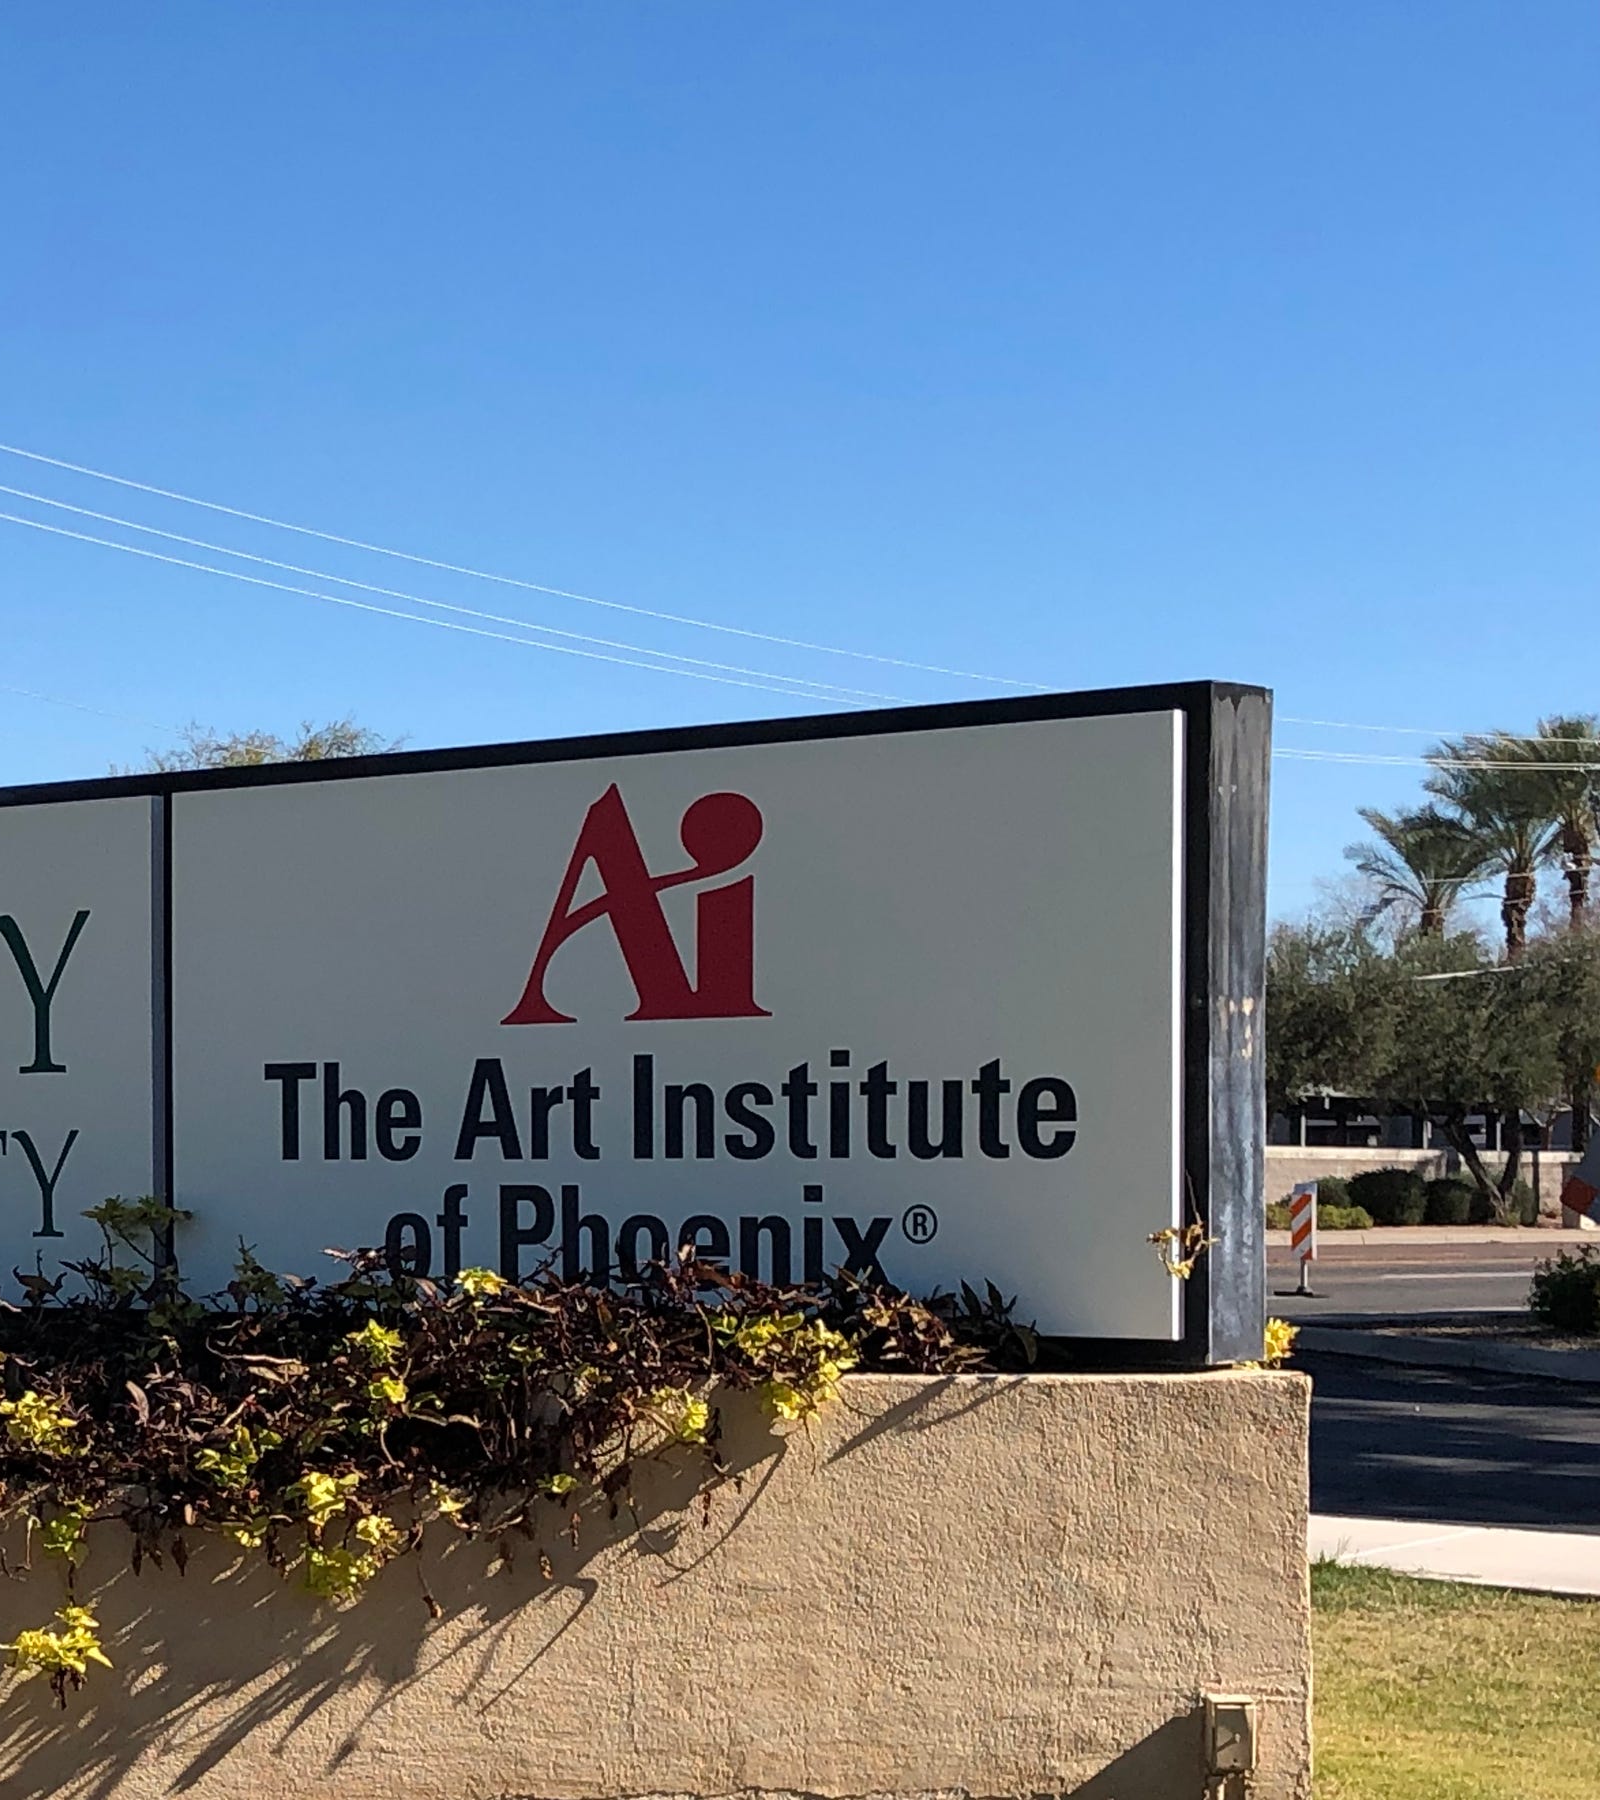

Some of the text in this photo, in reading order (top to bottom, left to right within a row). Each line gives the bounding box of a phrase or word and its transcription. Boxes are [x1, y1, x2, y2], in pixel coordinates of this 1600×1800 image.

[500, 783, 773, 1026] Ai
[263, 1049, 1079, 1162] The Art Institute
[385, 1184, 469, 1280] of
